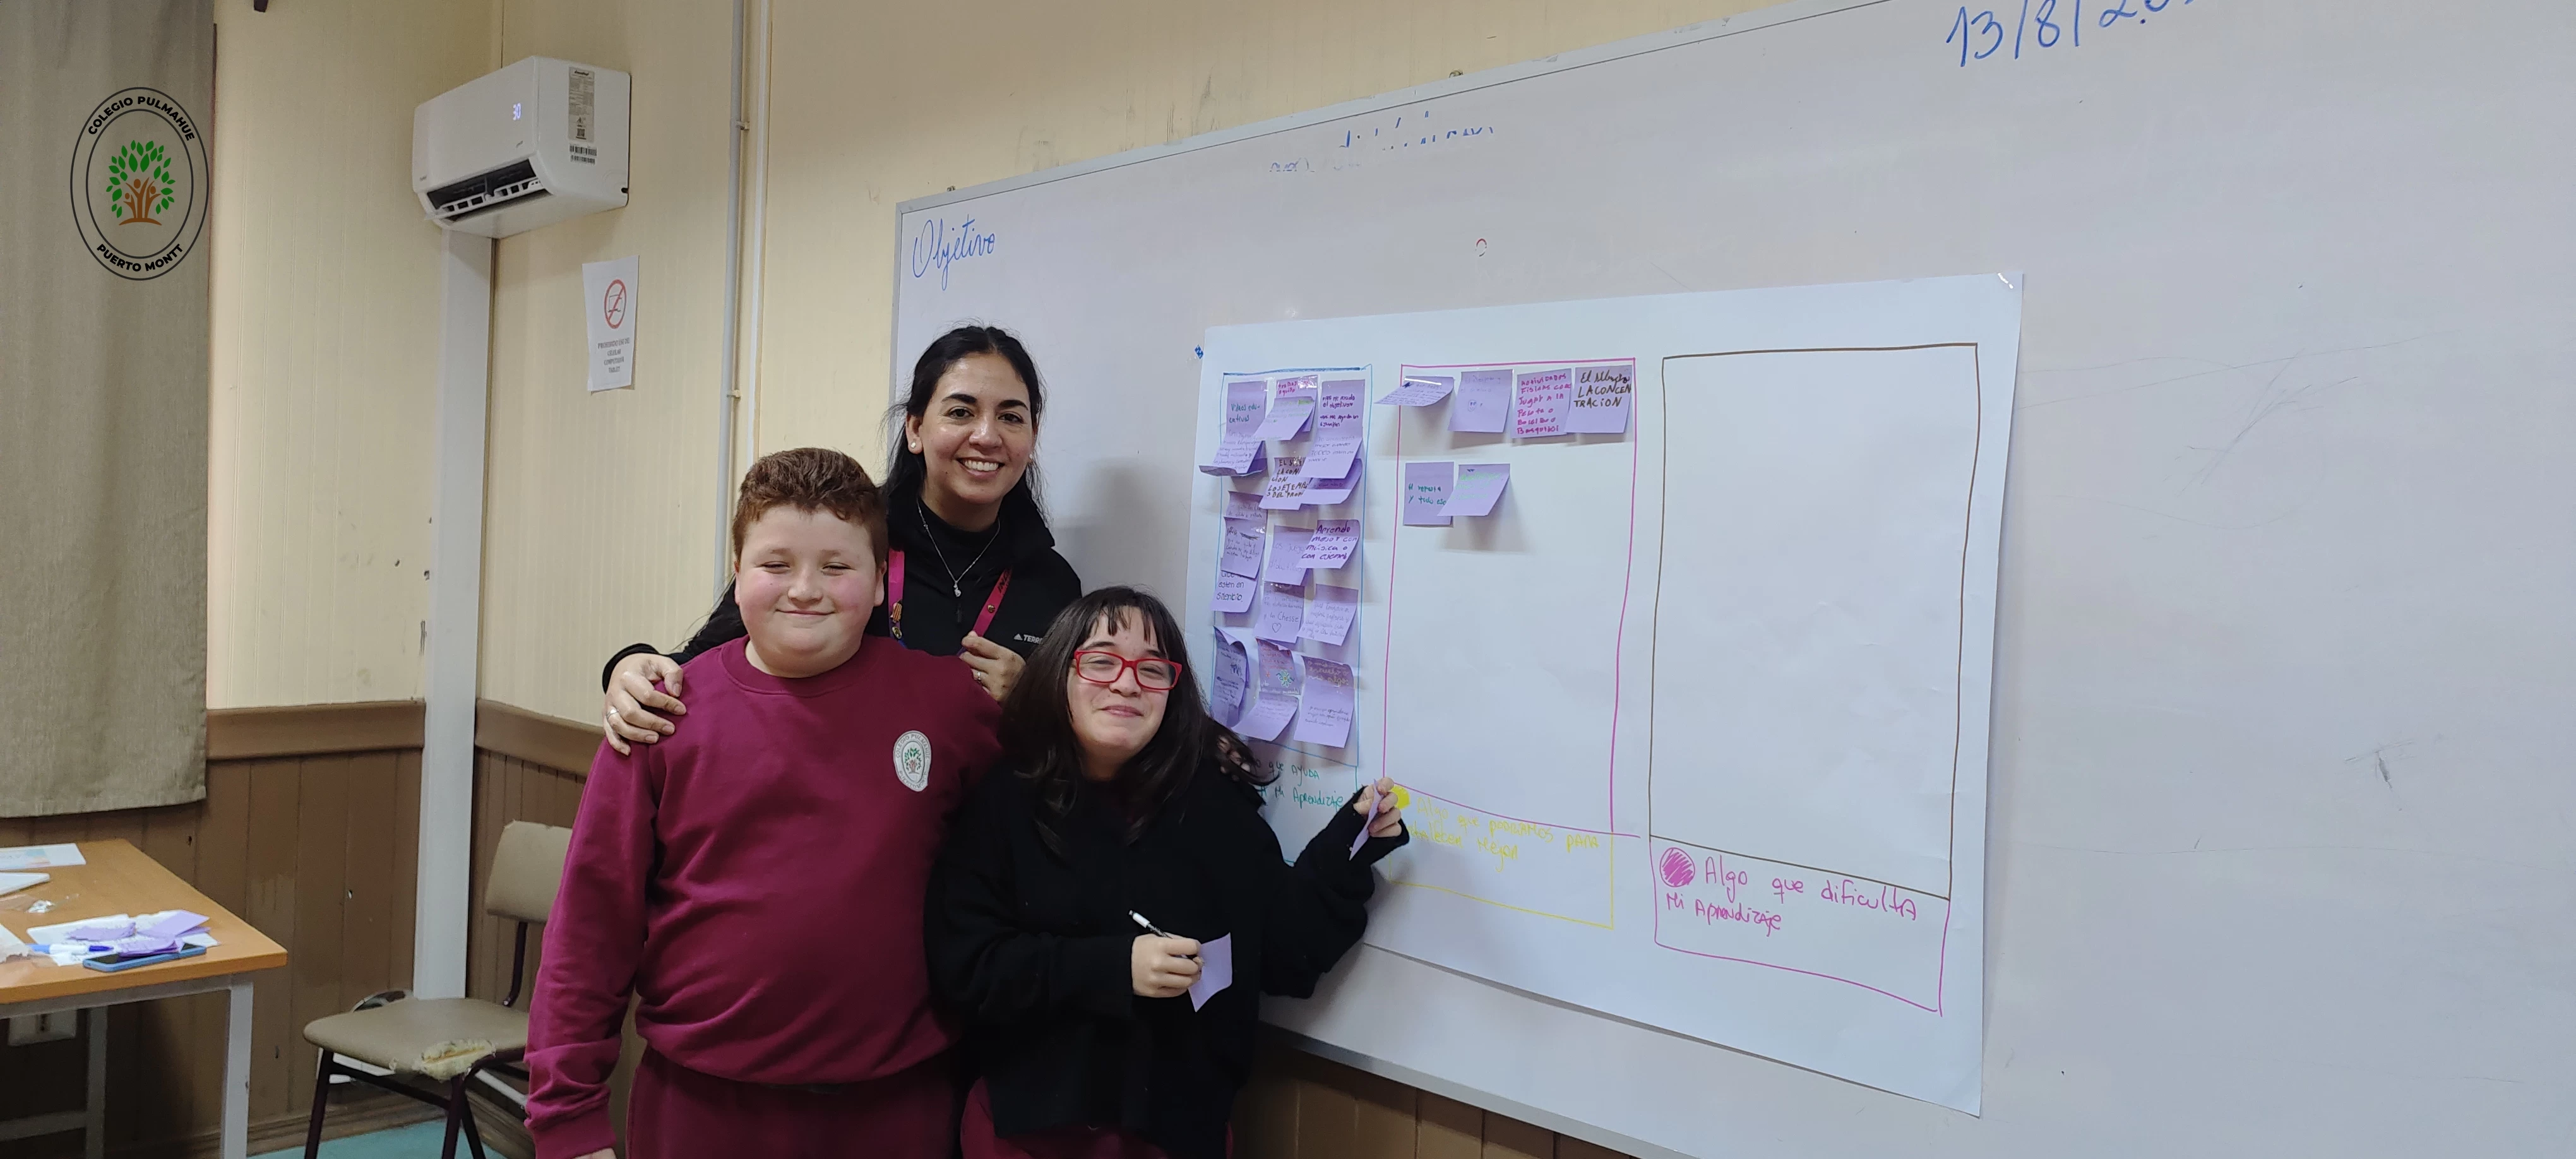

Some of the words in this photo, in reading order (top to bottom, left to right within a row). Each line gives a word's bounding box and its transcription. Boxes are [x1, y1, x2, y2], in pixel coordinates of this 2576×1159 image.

[513, 102, 521, 121] 30
[913, 214, 995, 290] Objetivo
[895, 735, 910, 758] COLEGIO
[1291, 764, 1320, 787] AYUDA
[1705, 855, 1748, 903] Algo
[1771, 877, 1804, 904] que
